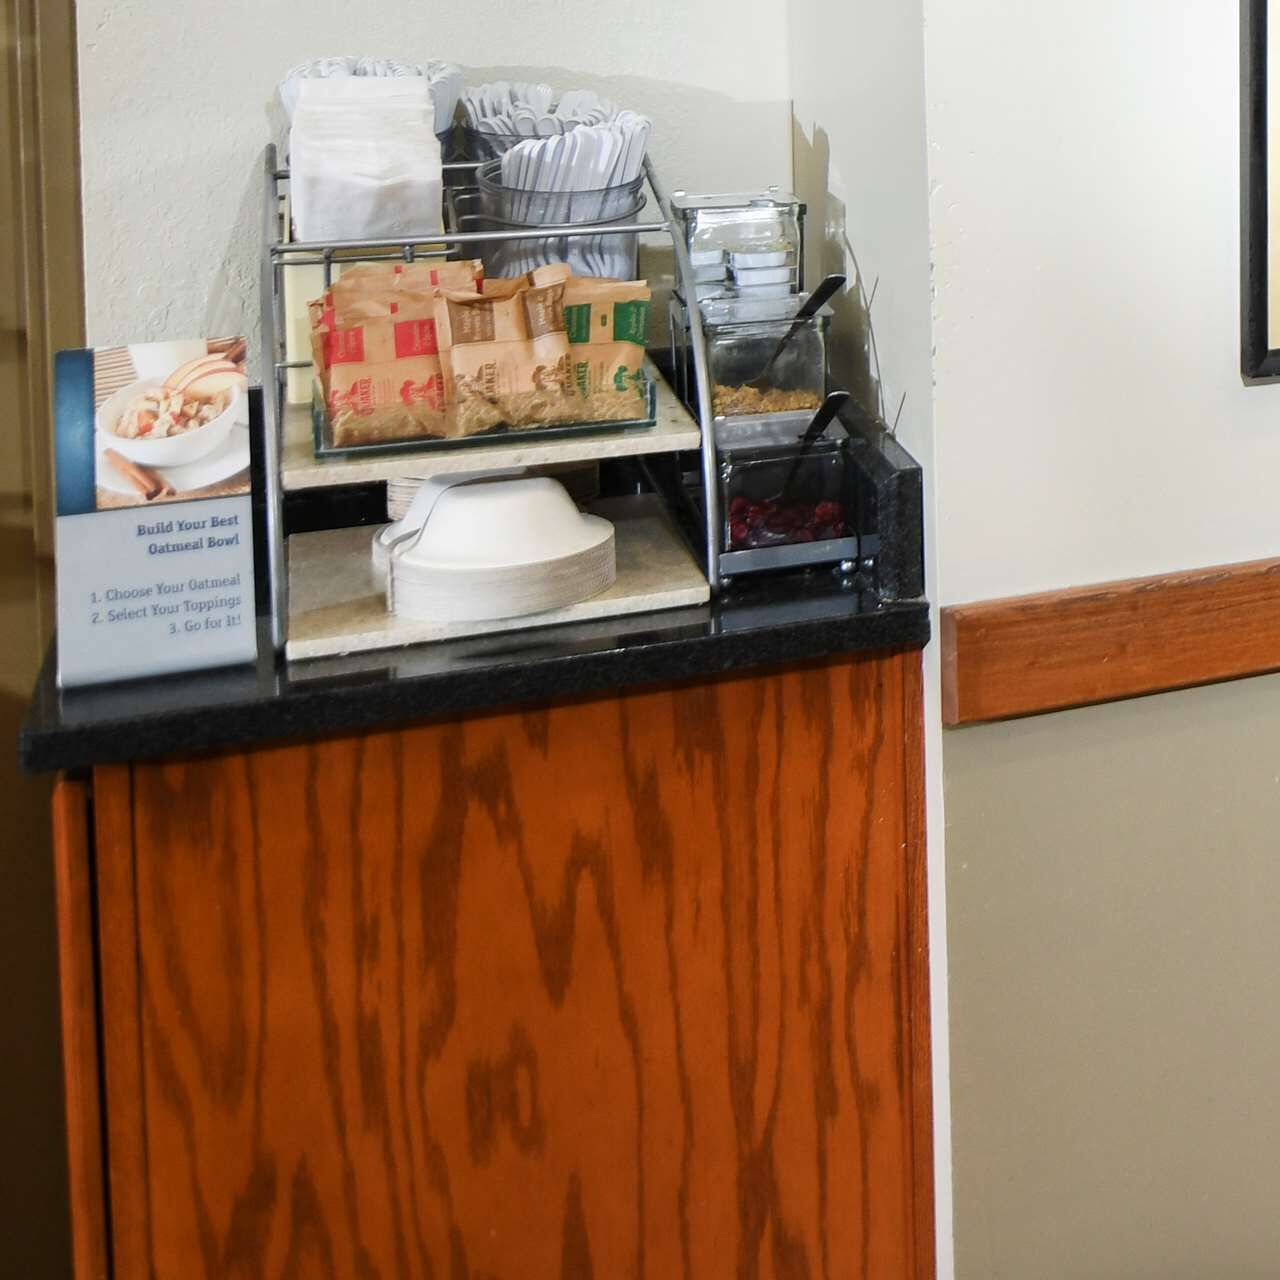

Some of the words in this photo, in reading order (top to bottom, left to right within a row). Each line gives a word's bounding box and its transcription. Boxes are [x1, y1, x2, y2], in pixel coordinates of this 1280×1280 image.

[136, 521, 173, 536] Build
[177, 519, 207, 532] Your
[210, 515, 239, 528] Best
[148, 537, 203, 555] Oatmeal
[207, 534, 240, 548] Bowl
[90, 592, 102, 604] 1.
[106, 588, 152, 602] Choose
[156, 583, 184, 596] Your
[188, 574, 240, 591] Oatmeal
[92, 612, 104, 624] 2.
[108, 608, 146, 622] Select
[151, 603, 180, 616] Your
[184, 596, 242, 613] Toppings
[170, 623, 180, 634] 3.
[184, 620, 202, 632] Go
[204, 618, 222, 630] for
[226, 615, 241, 626] It!
